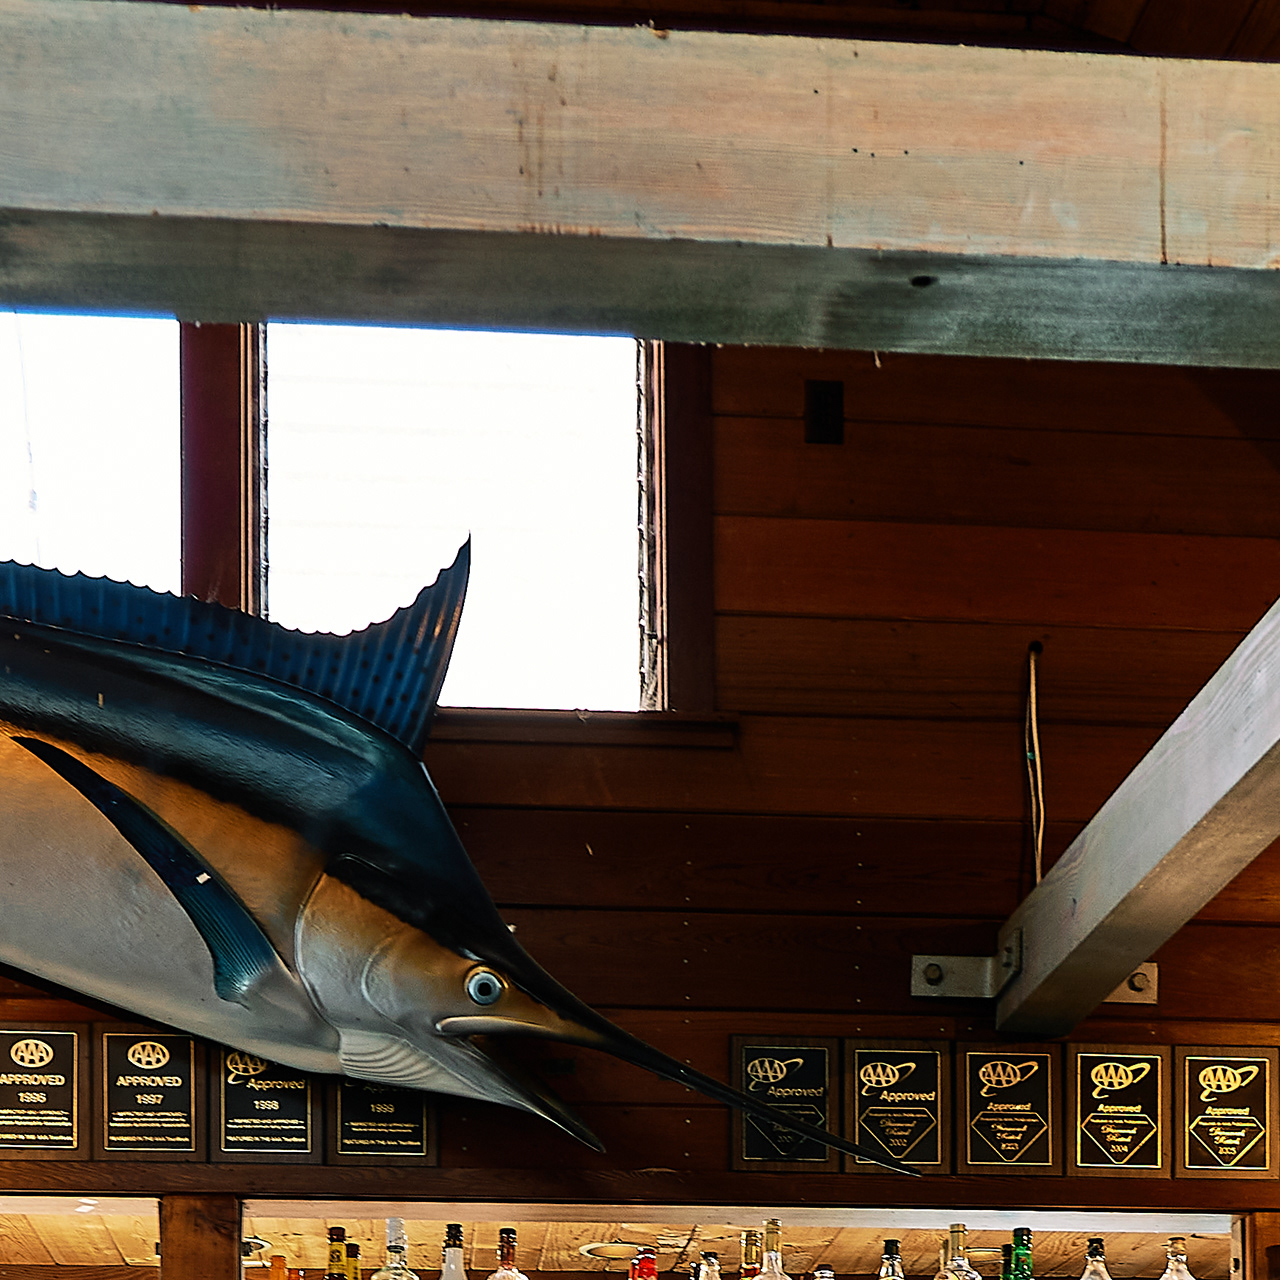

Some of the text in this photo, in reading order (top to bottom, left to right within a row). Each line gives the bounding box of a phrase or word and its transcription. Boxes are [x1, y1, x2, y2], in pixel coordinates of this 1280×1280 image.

[116, 1076, 182, 1087] APPROVED
[246, 1078, 305, 1091] Approved
[767, 1086, 824, 1098] Approved
[879, 1090, 936, 1102] Approved
[987, 1102, 1032, 1111] Approved
[1097, 1103, 1142, 1113] Approved
[1205, 1106, 1250, 1115] Approved
